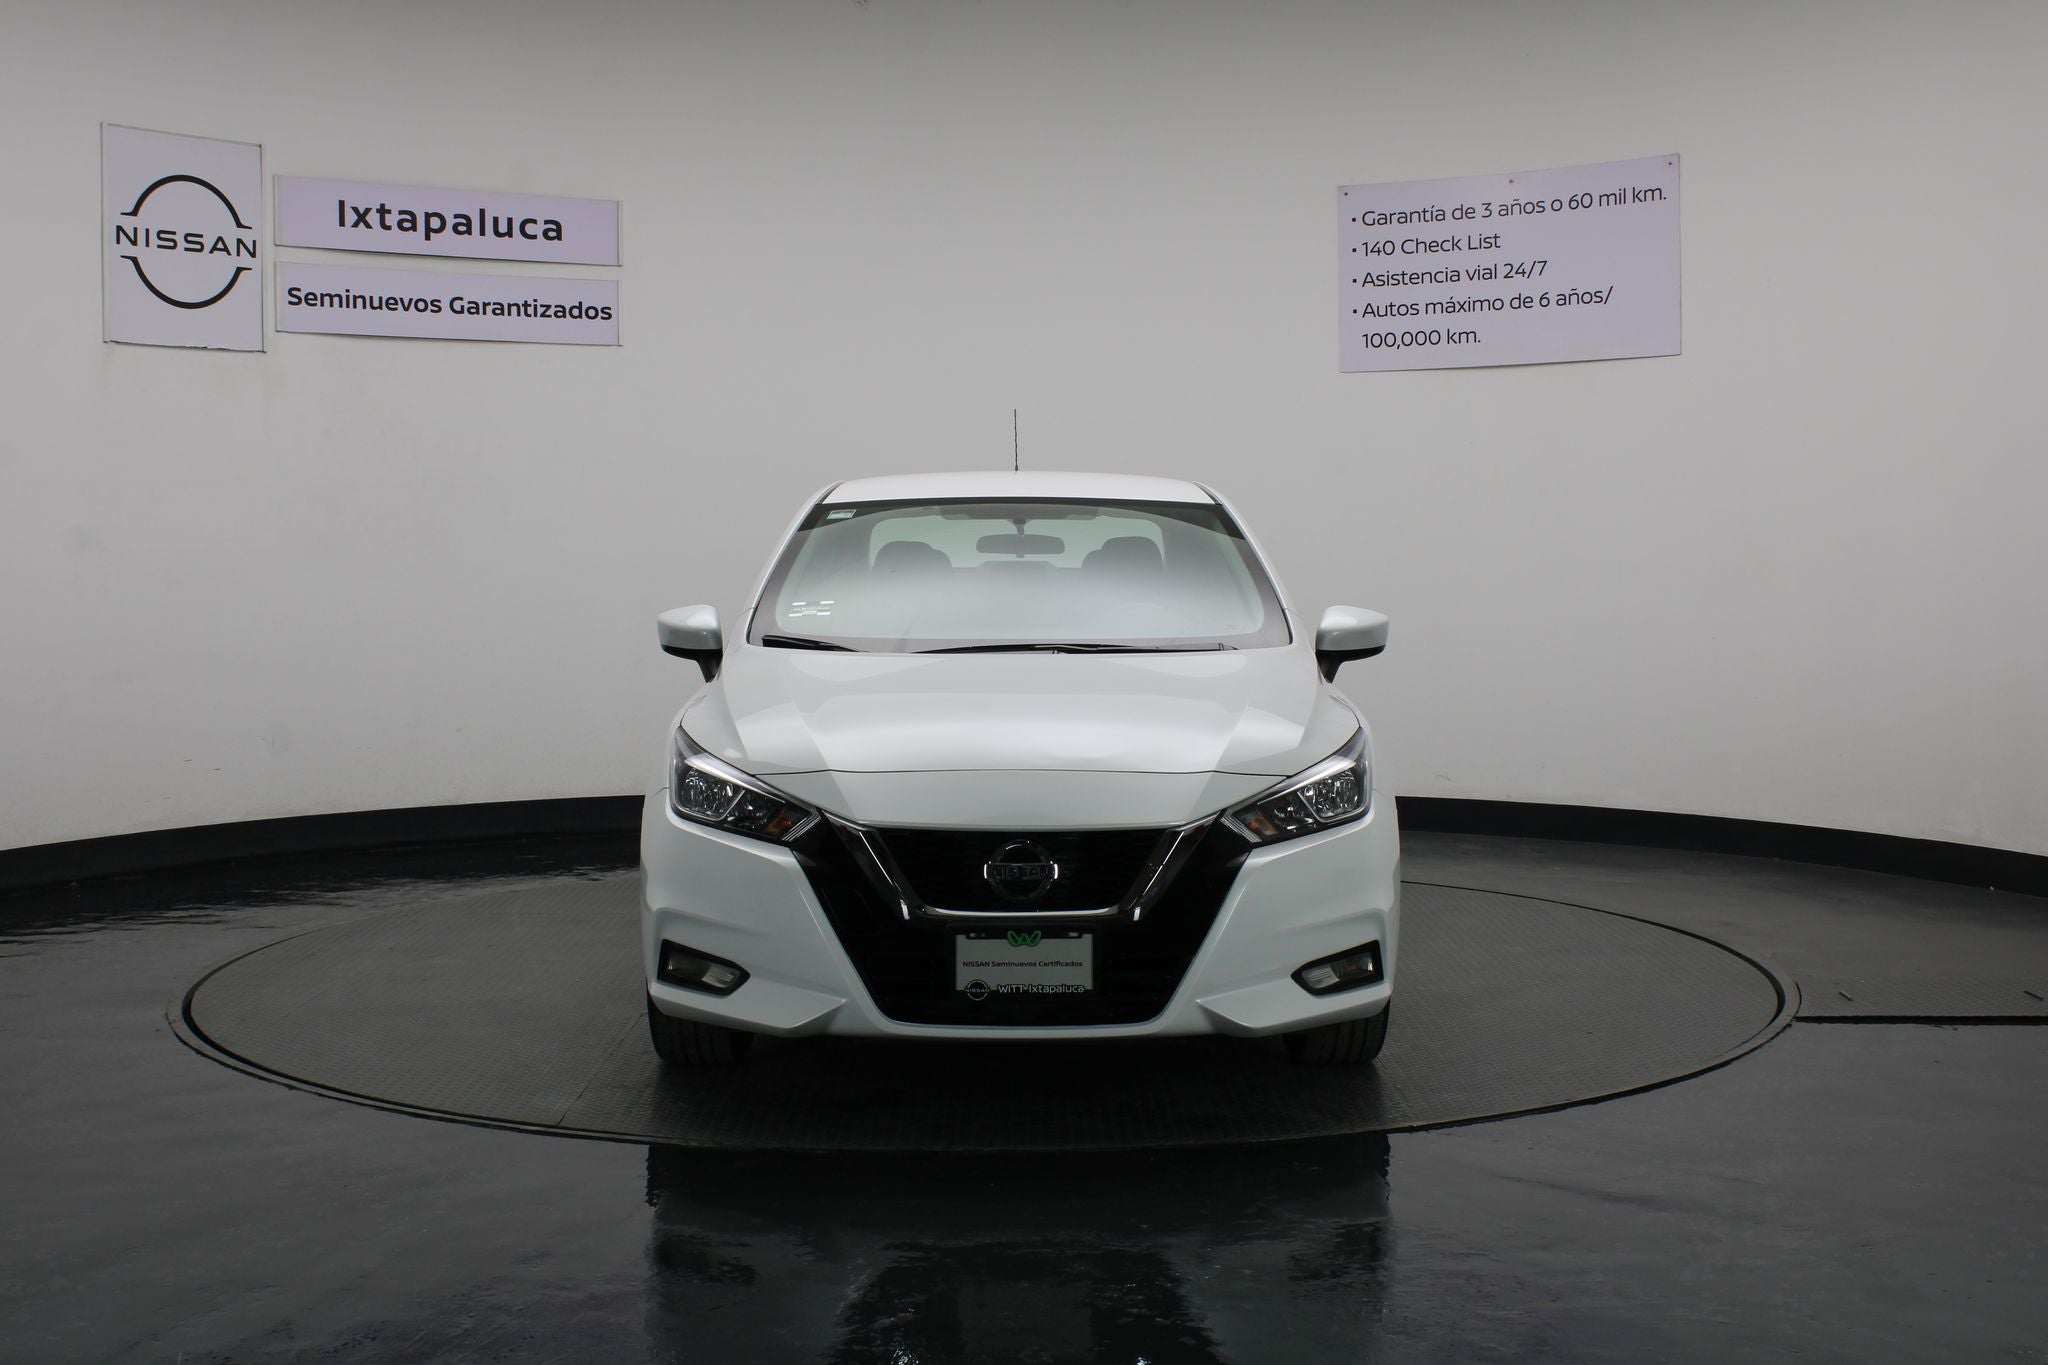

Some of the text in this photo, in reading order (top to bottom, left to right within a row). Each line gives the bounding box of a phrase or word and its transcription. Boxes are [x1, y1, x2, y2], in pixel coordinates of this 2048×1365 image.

[338, 199, 563, 242] Ixtapaluca
[1361, 186, 1668, 227] Garantía de 3 años o 60 mil km.
[115, 224, 257, 259] NISSAN
[1361, 233, 1502, 257] 140 Check List
[1361, 260, 1548, 288] Asistencia vial 24/7
[287, 286, 613, 321] Seminuevos Garantizados
[1361, 285, 1614, 319] Autos máximo de 6 años/
[1361, 328, 1482, 351] 100,000 km.
[992, 866, 1051, 878] NISSAN
[962, 959, 1083, 968] NISSAN Seminuevos Certificados
